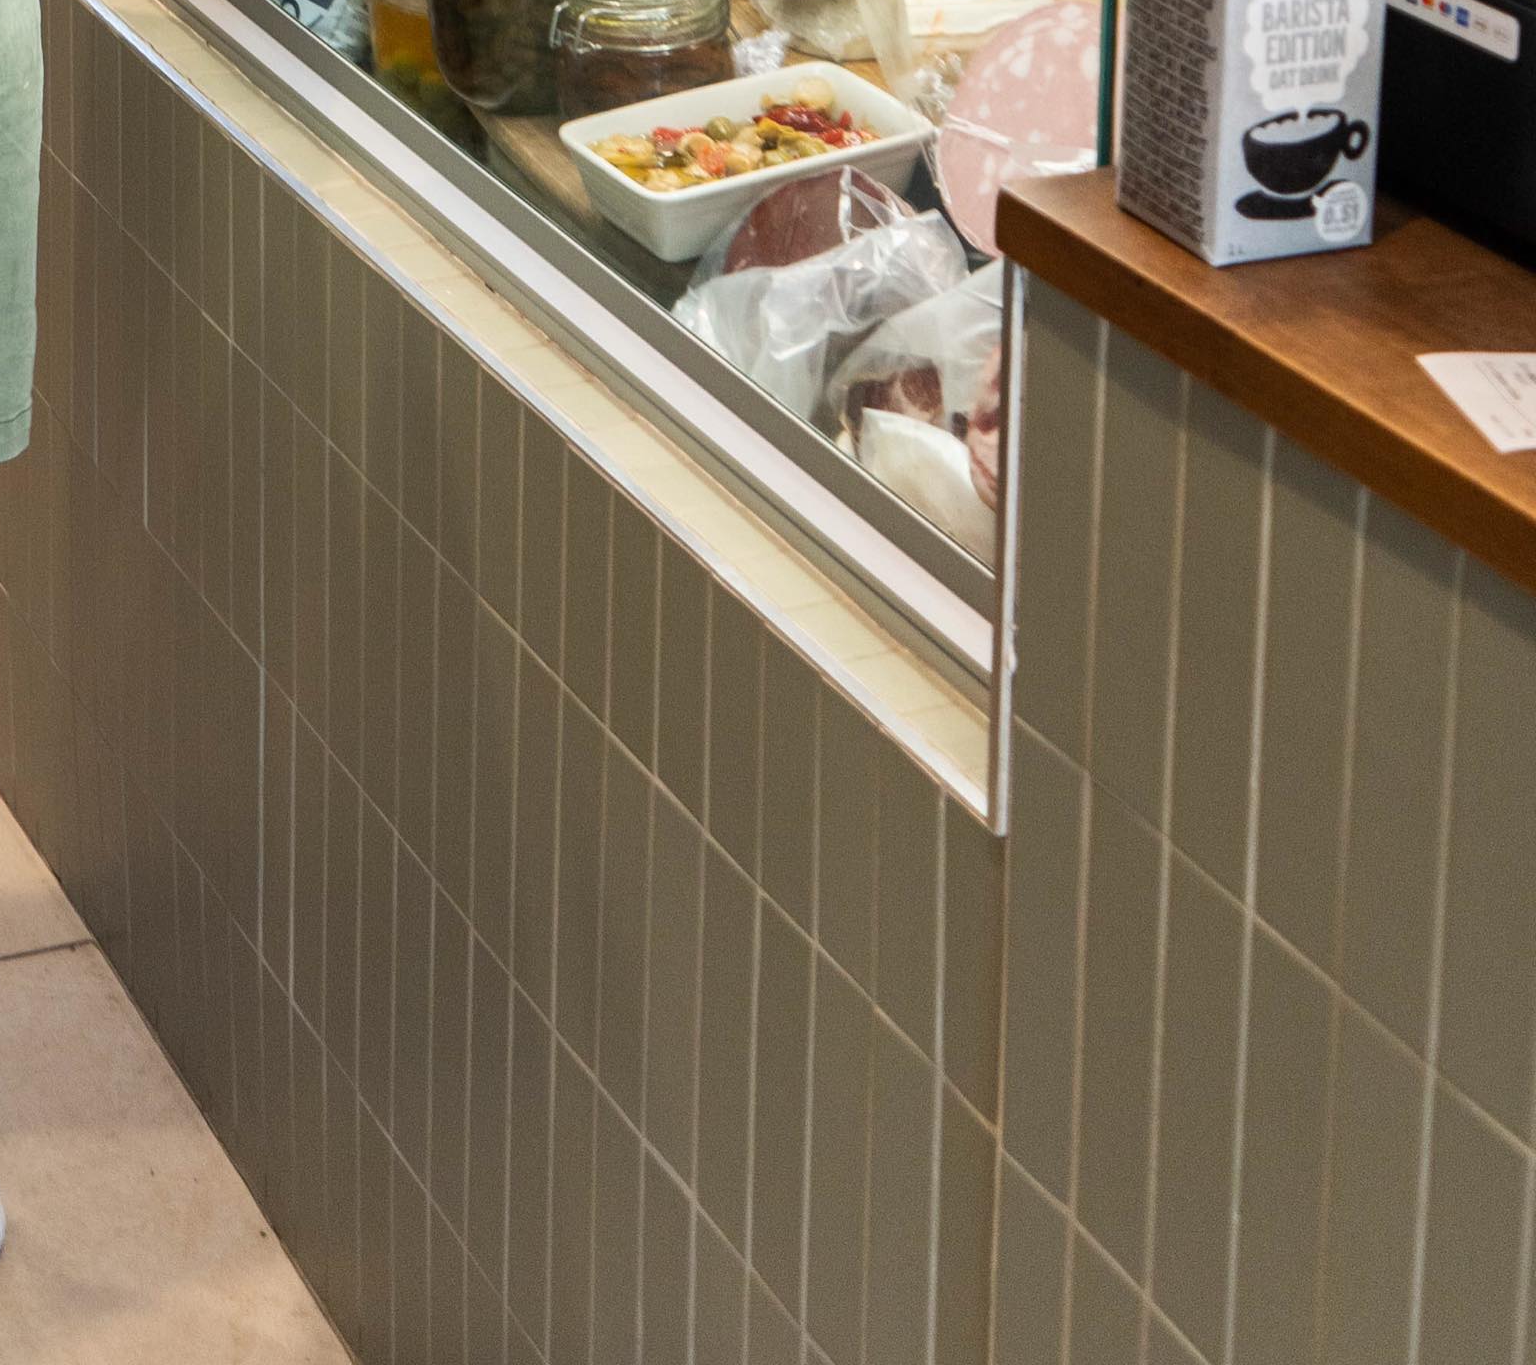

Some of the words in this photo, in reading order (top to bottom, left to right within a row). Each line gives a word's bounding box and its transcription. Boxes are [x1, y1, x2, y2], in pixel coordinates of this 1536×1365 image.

[1265, 27, 1347, 65] EDITION
[1269, 68, 1298, 90] OAT
[1298, 63, 1340, 86] DRINK
